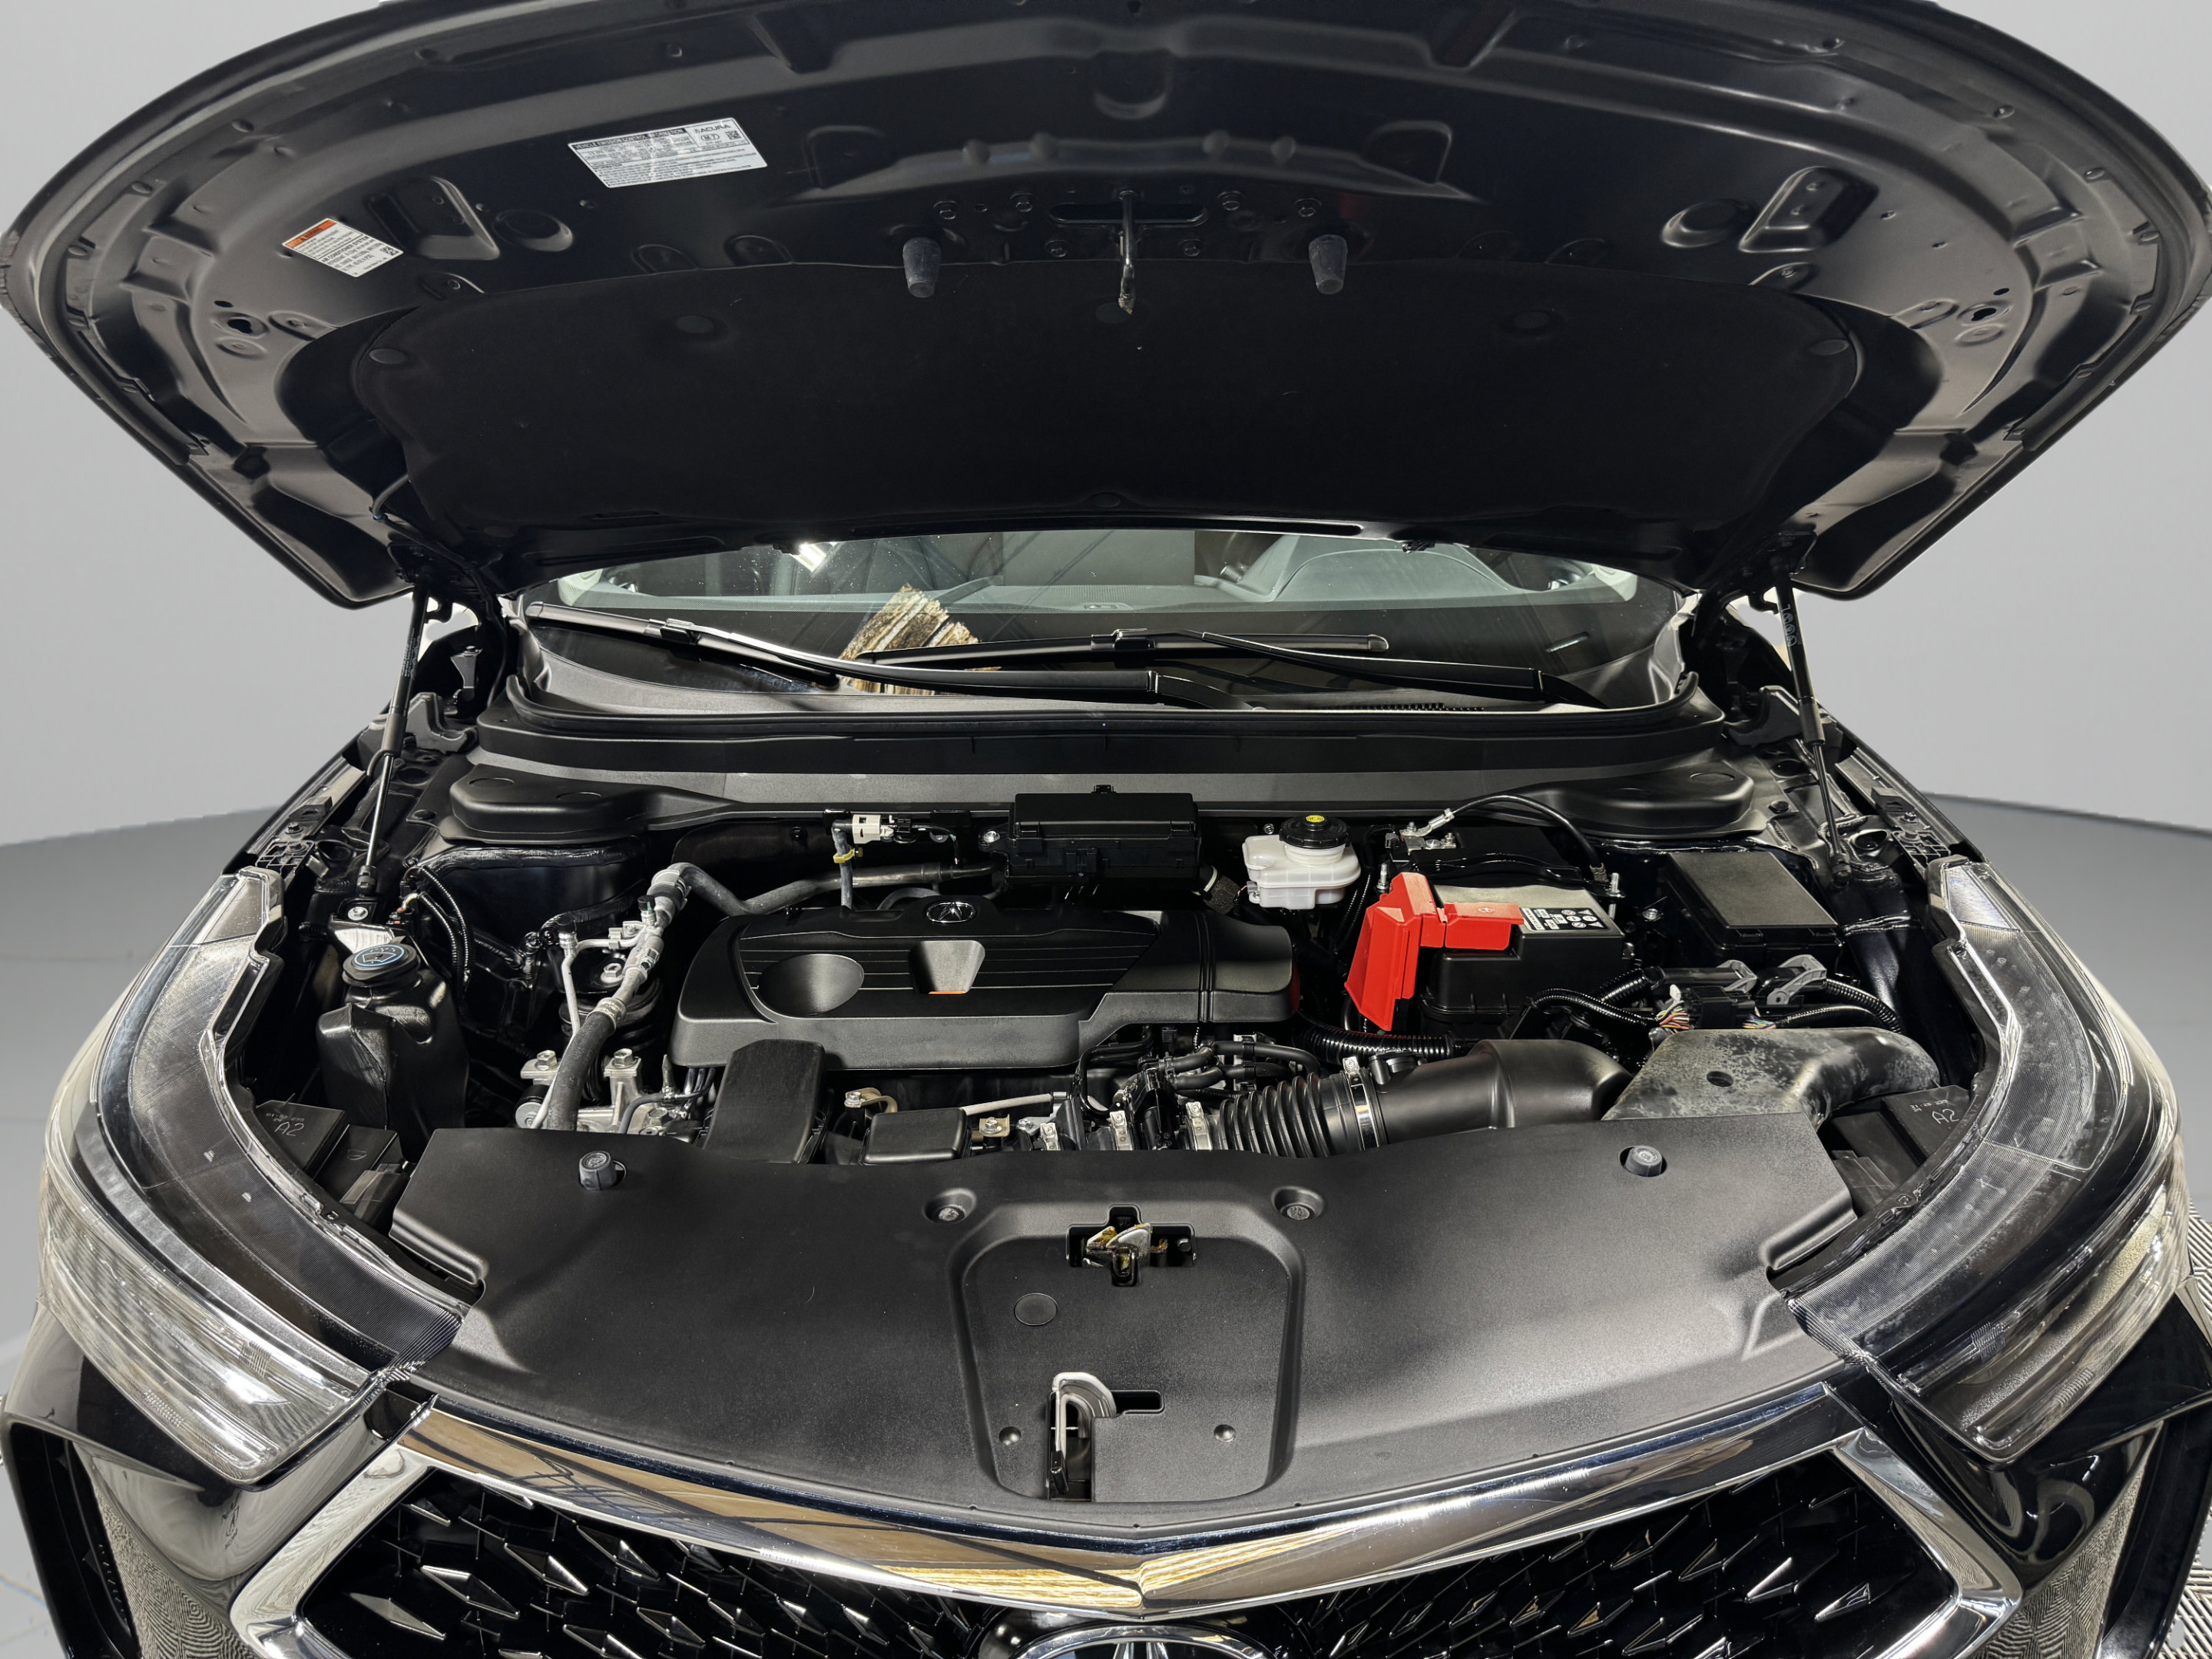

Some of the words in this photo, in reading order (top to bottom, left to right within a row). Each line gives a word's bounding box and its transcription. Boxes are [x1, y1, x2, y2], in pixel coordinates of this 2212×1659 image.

[700, 124, 731, 133] ACURA
[327, 244, 353, 259] CONDITIONER
[352, 236, 369, 246] SYSTEM
[1932, 1108, 1959, 1124] A2
[274, 1121, 304, 1137] A2
